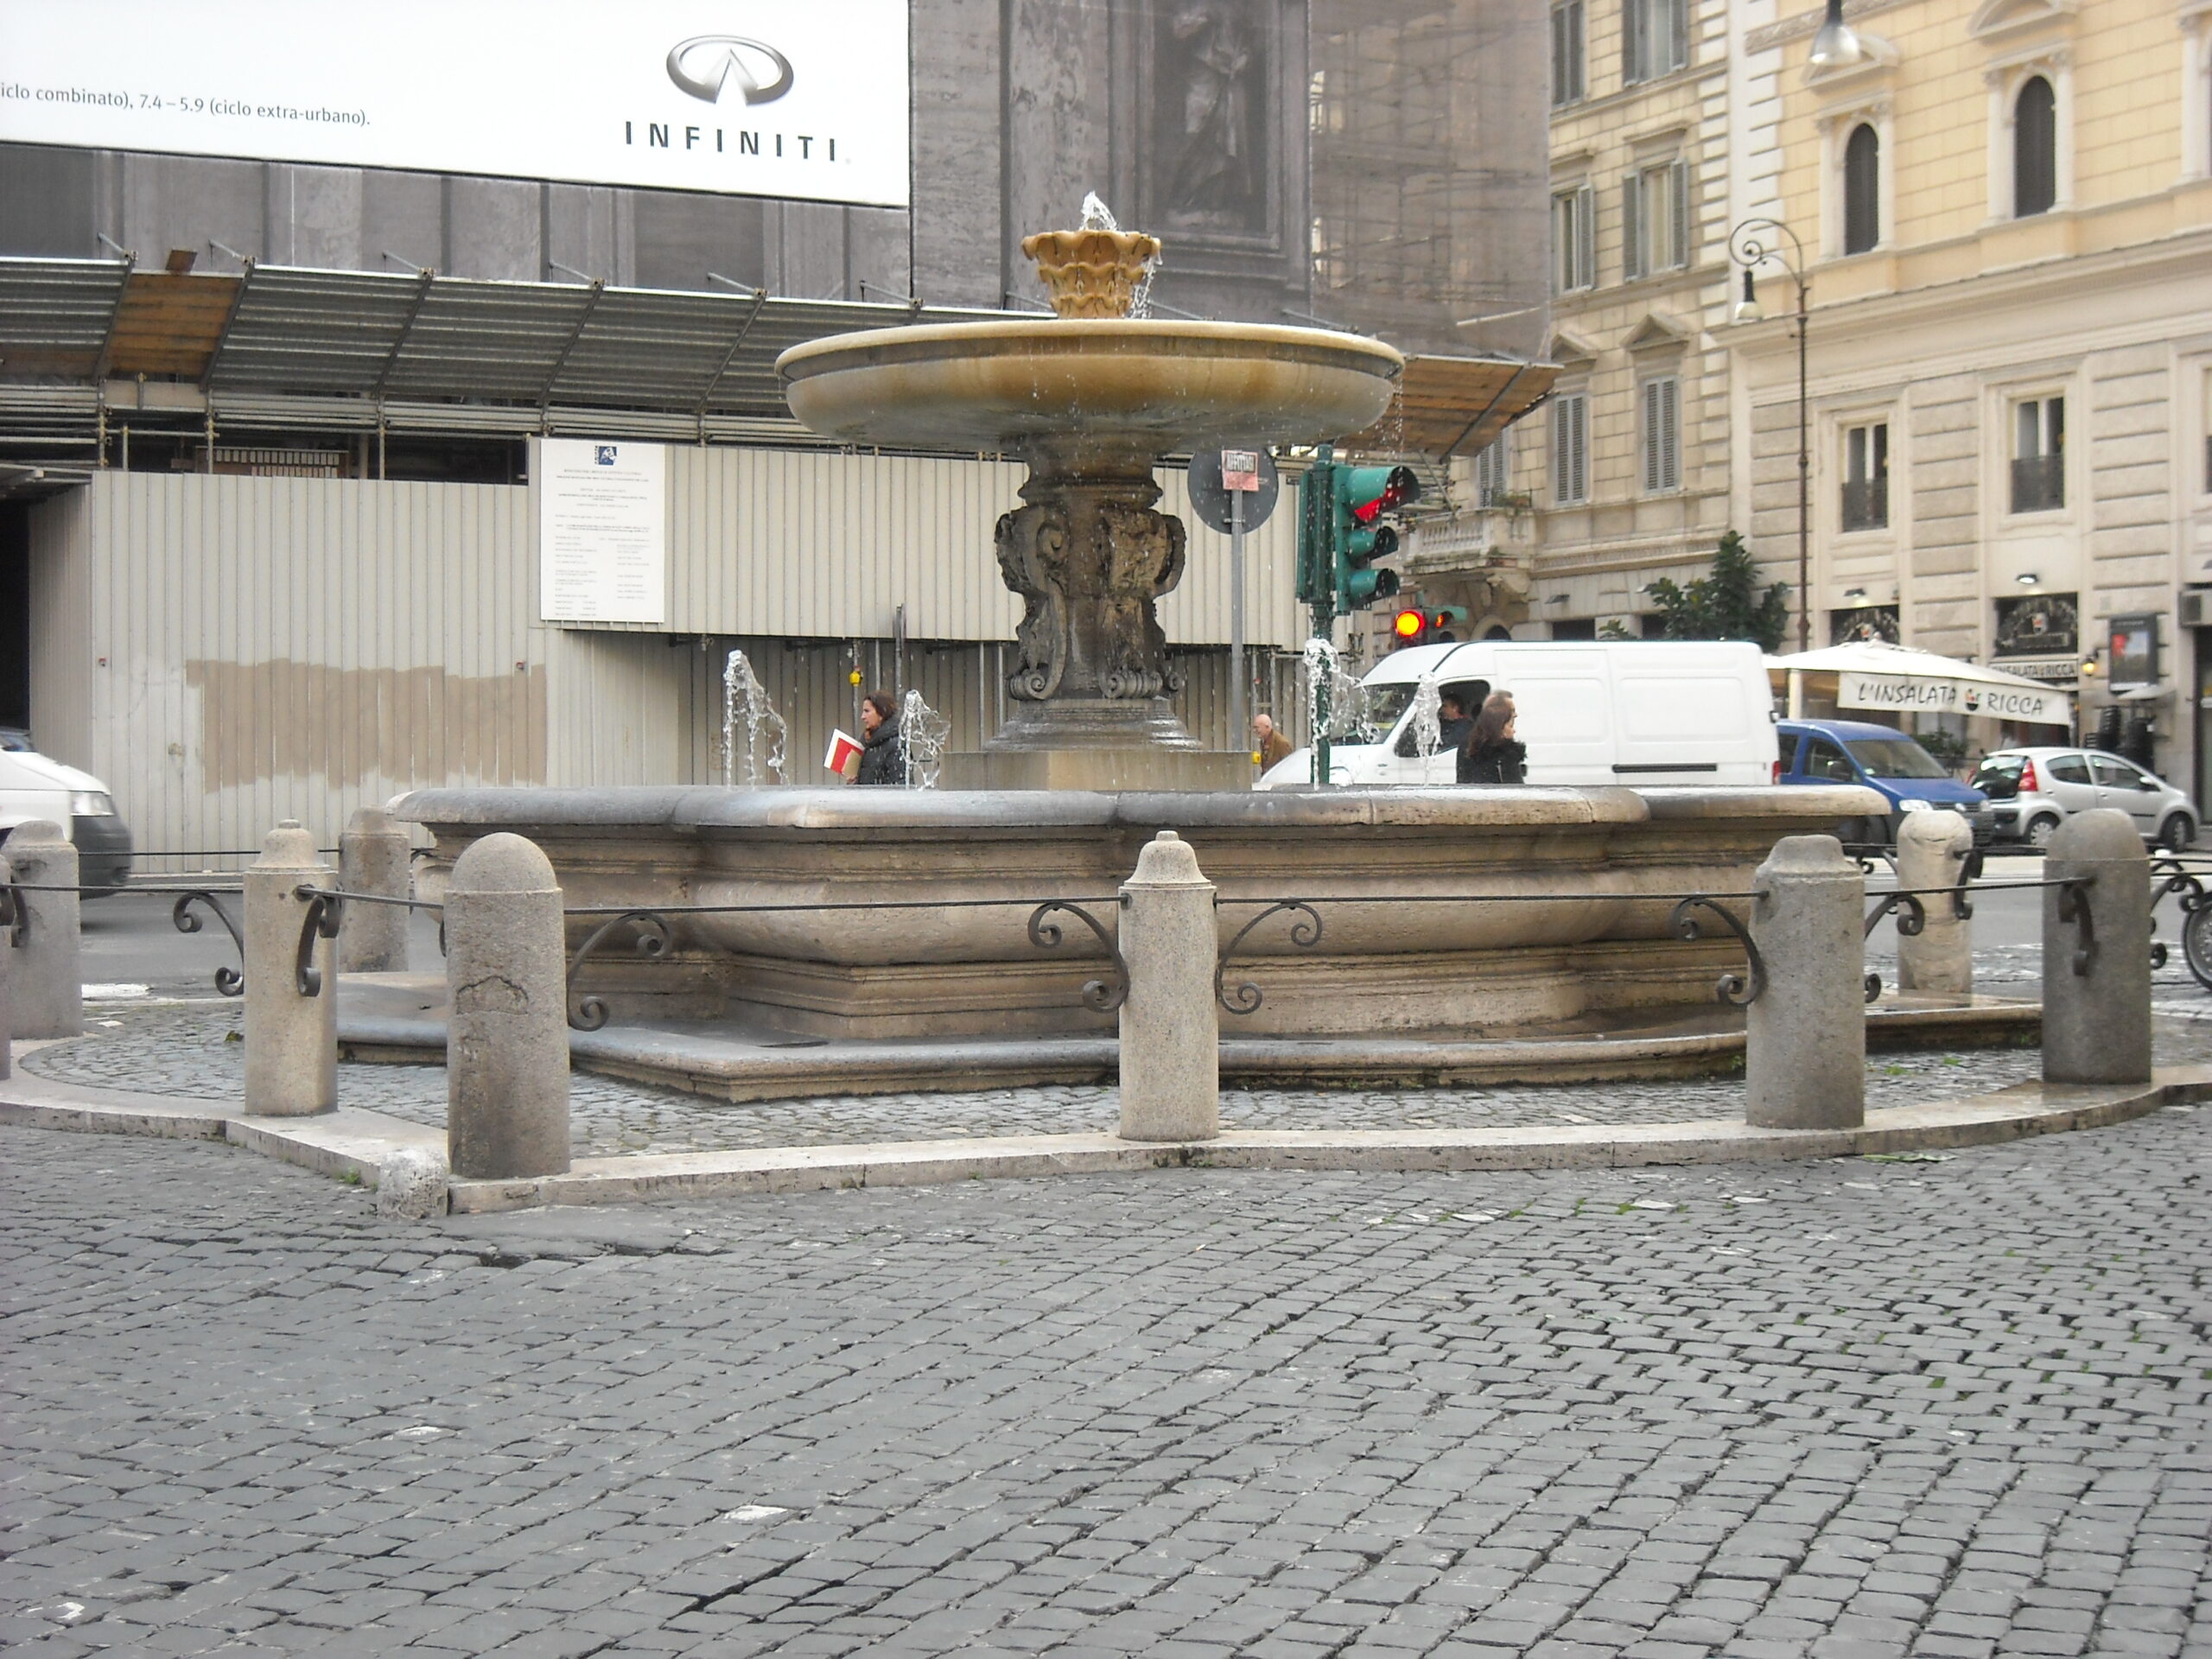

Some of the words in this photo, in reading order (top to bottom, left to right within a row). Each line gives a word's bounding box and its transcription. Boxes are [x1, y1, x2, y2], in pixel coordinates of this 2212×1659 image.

[36, 87, 134, 110] combinato),
[140, 93, 162, 110] 7.4
[180, 96, 204, 112] 5.9
[209, 97, 251, 117] (ciclo
[257, 105, 371, 127] extra-urbano).
[626, 120, 835, 162] INFINITI
[2045, 663, 2075, 677] RICCA
[1858, 683, 1957, 705] L'INSALATA
[1987, 692, 2044, 715] RICCA
